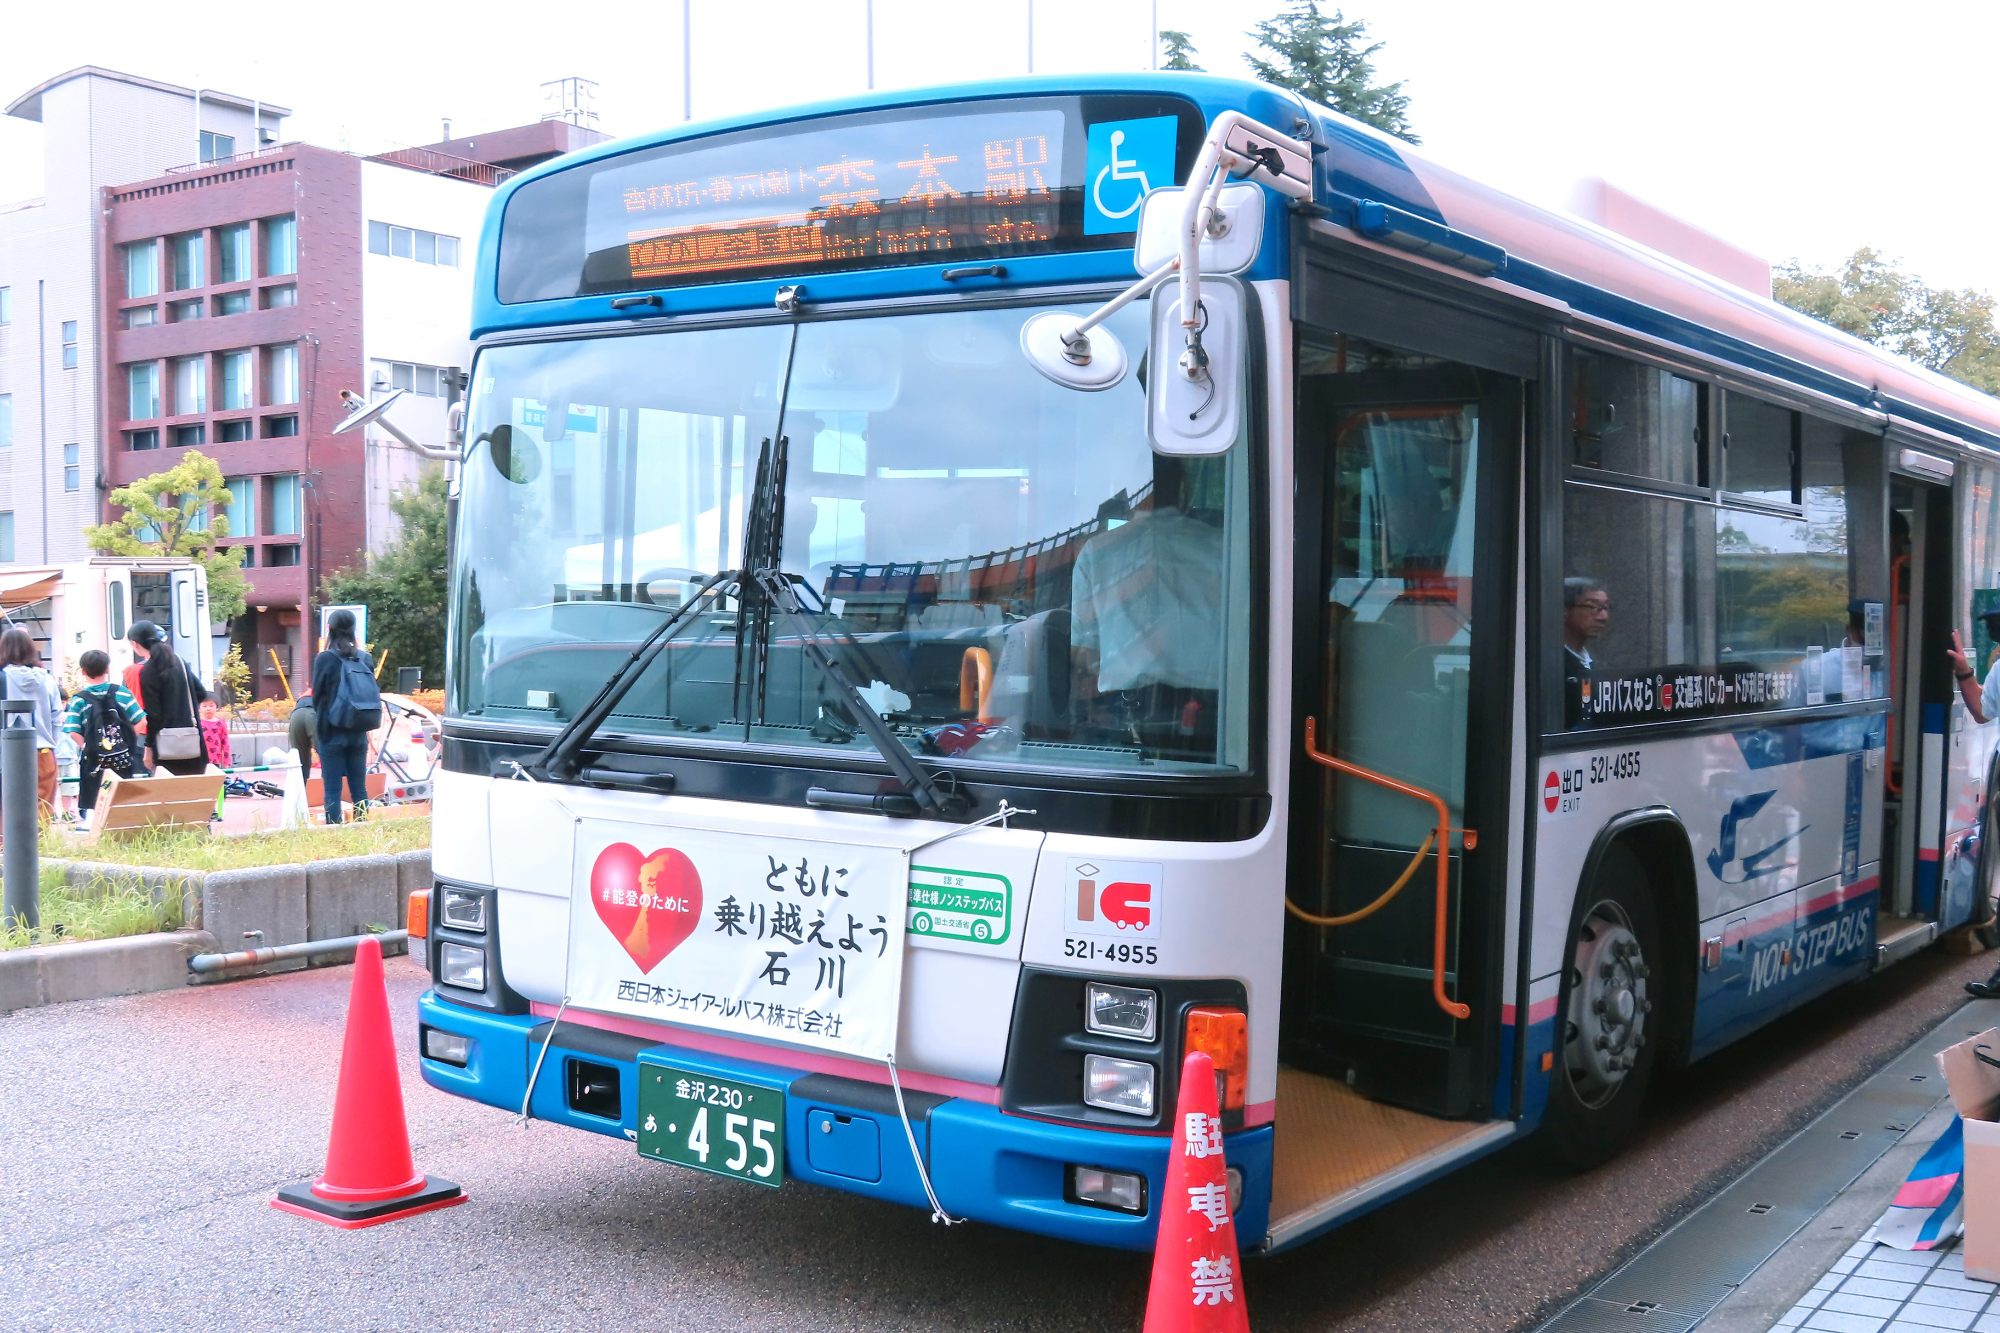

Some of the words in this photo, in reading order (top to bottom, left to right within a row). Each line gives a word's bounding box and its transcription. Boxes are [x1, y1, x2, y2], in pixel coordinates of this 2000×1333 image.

[1562, 768, 1583, 794] 出口
[1590, 750, 1641, 784] 521-4955
[1562, 797, 1581, 813] EXIT
[766, 854, 849, 898] ともに
[943, 875, 964, 887] 認定
[602, 886, 690, 914] #能登のために
[714, 894, 889, 958] 乗り越えよう
[934, 916, 970, 930] 国土交通省
[1064, 938, 1158, 965] 521-4955
[1792, 920, 1838, 976] STEP
[1835, 906, 1871, 957] BUS
[759, 951, 846, 999] 石川
[616, 979, 843, 1039] 西日本ジェイアールバス株式会社
